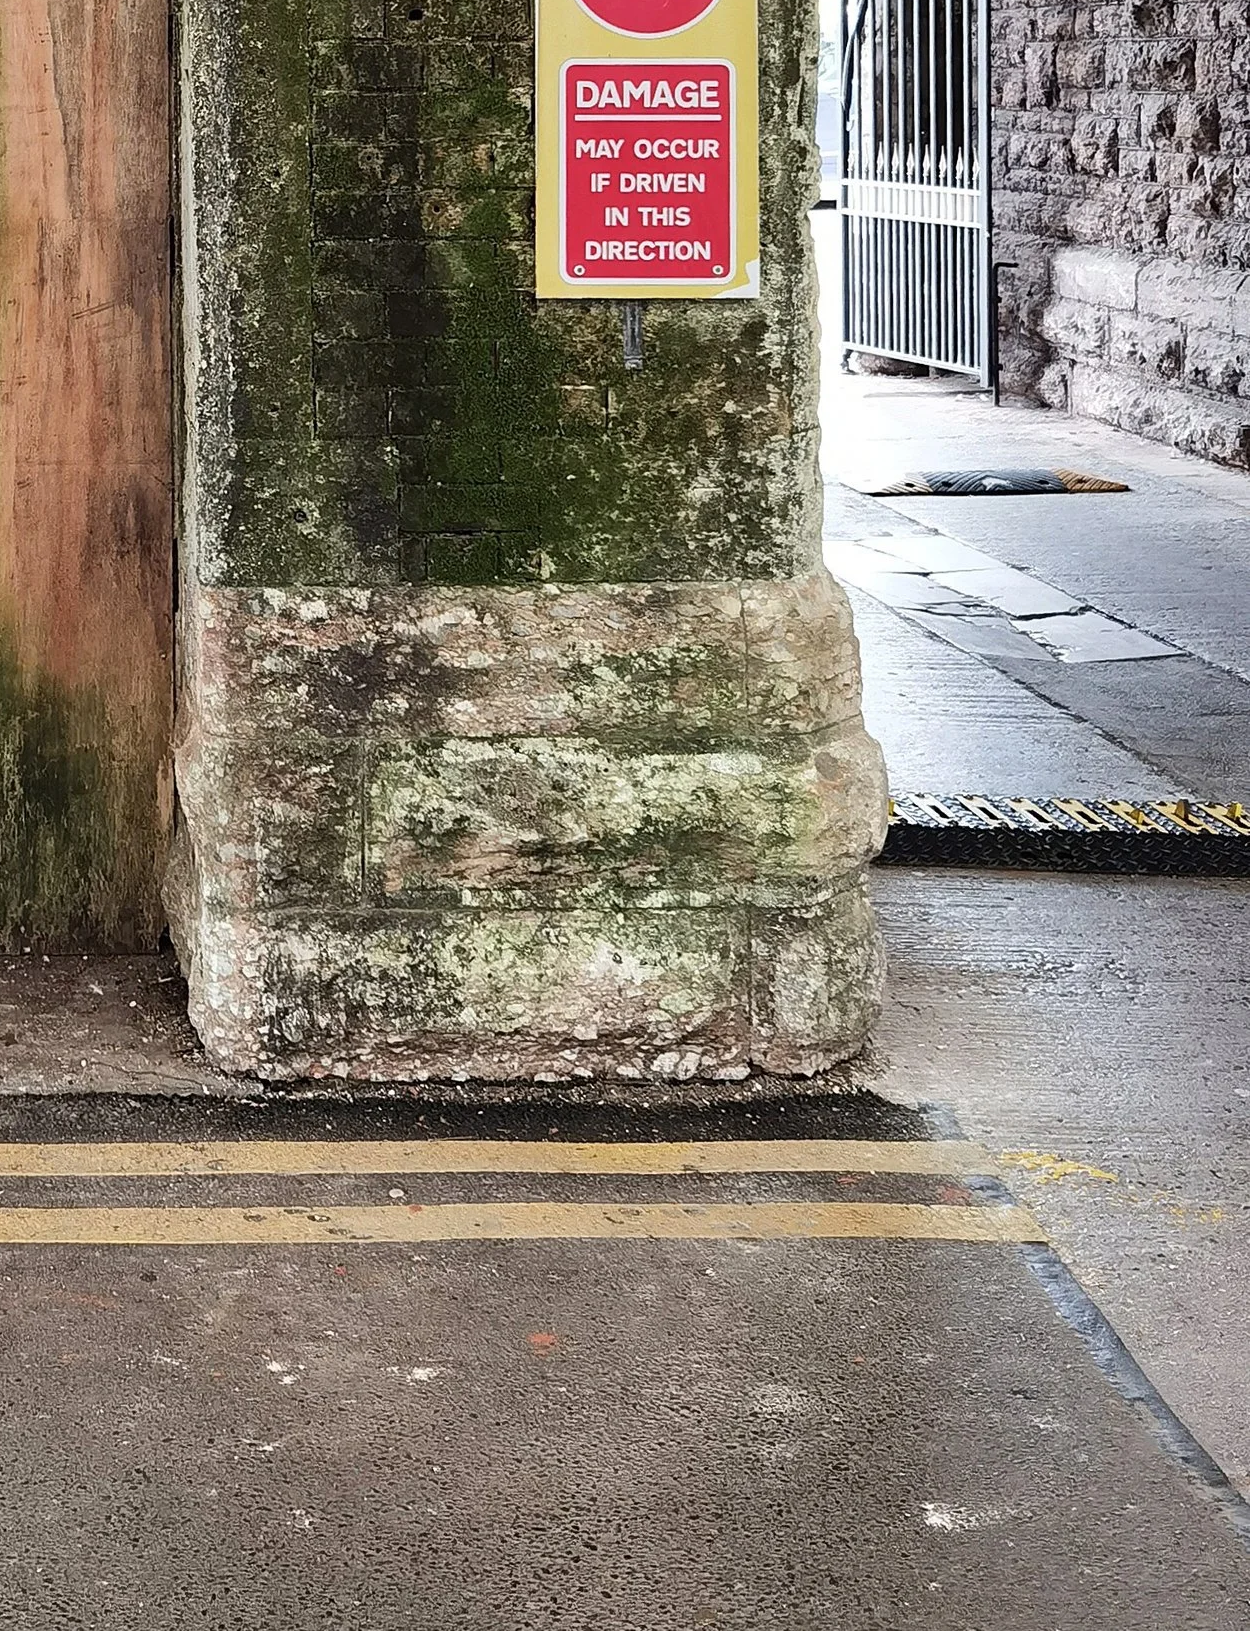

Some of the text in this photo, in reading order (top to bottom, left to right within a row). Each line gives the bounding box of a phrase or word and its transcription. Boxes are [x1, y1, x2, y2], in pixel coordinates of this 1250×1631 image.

[576, 81, 720, 108] DAMAGE
[576, 139, 720, 159] MAY OCCUR
[591, 173, 705, 193] IF DRIVEN
[604, 207, 691, 227] IN THIS
[585, 240, 711, 261] DIRECTION
